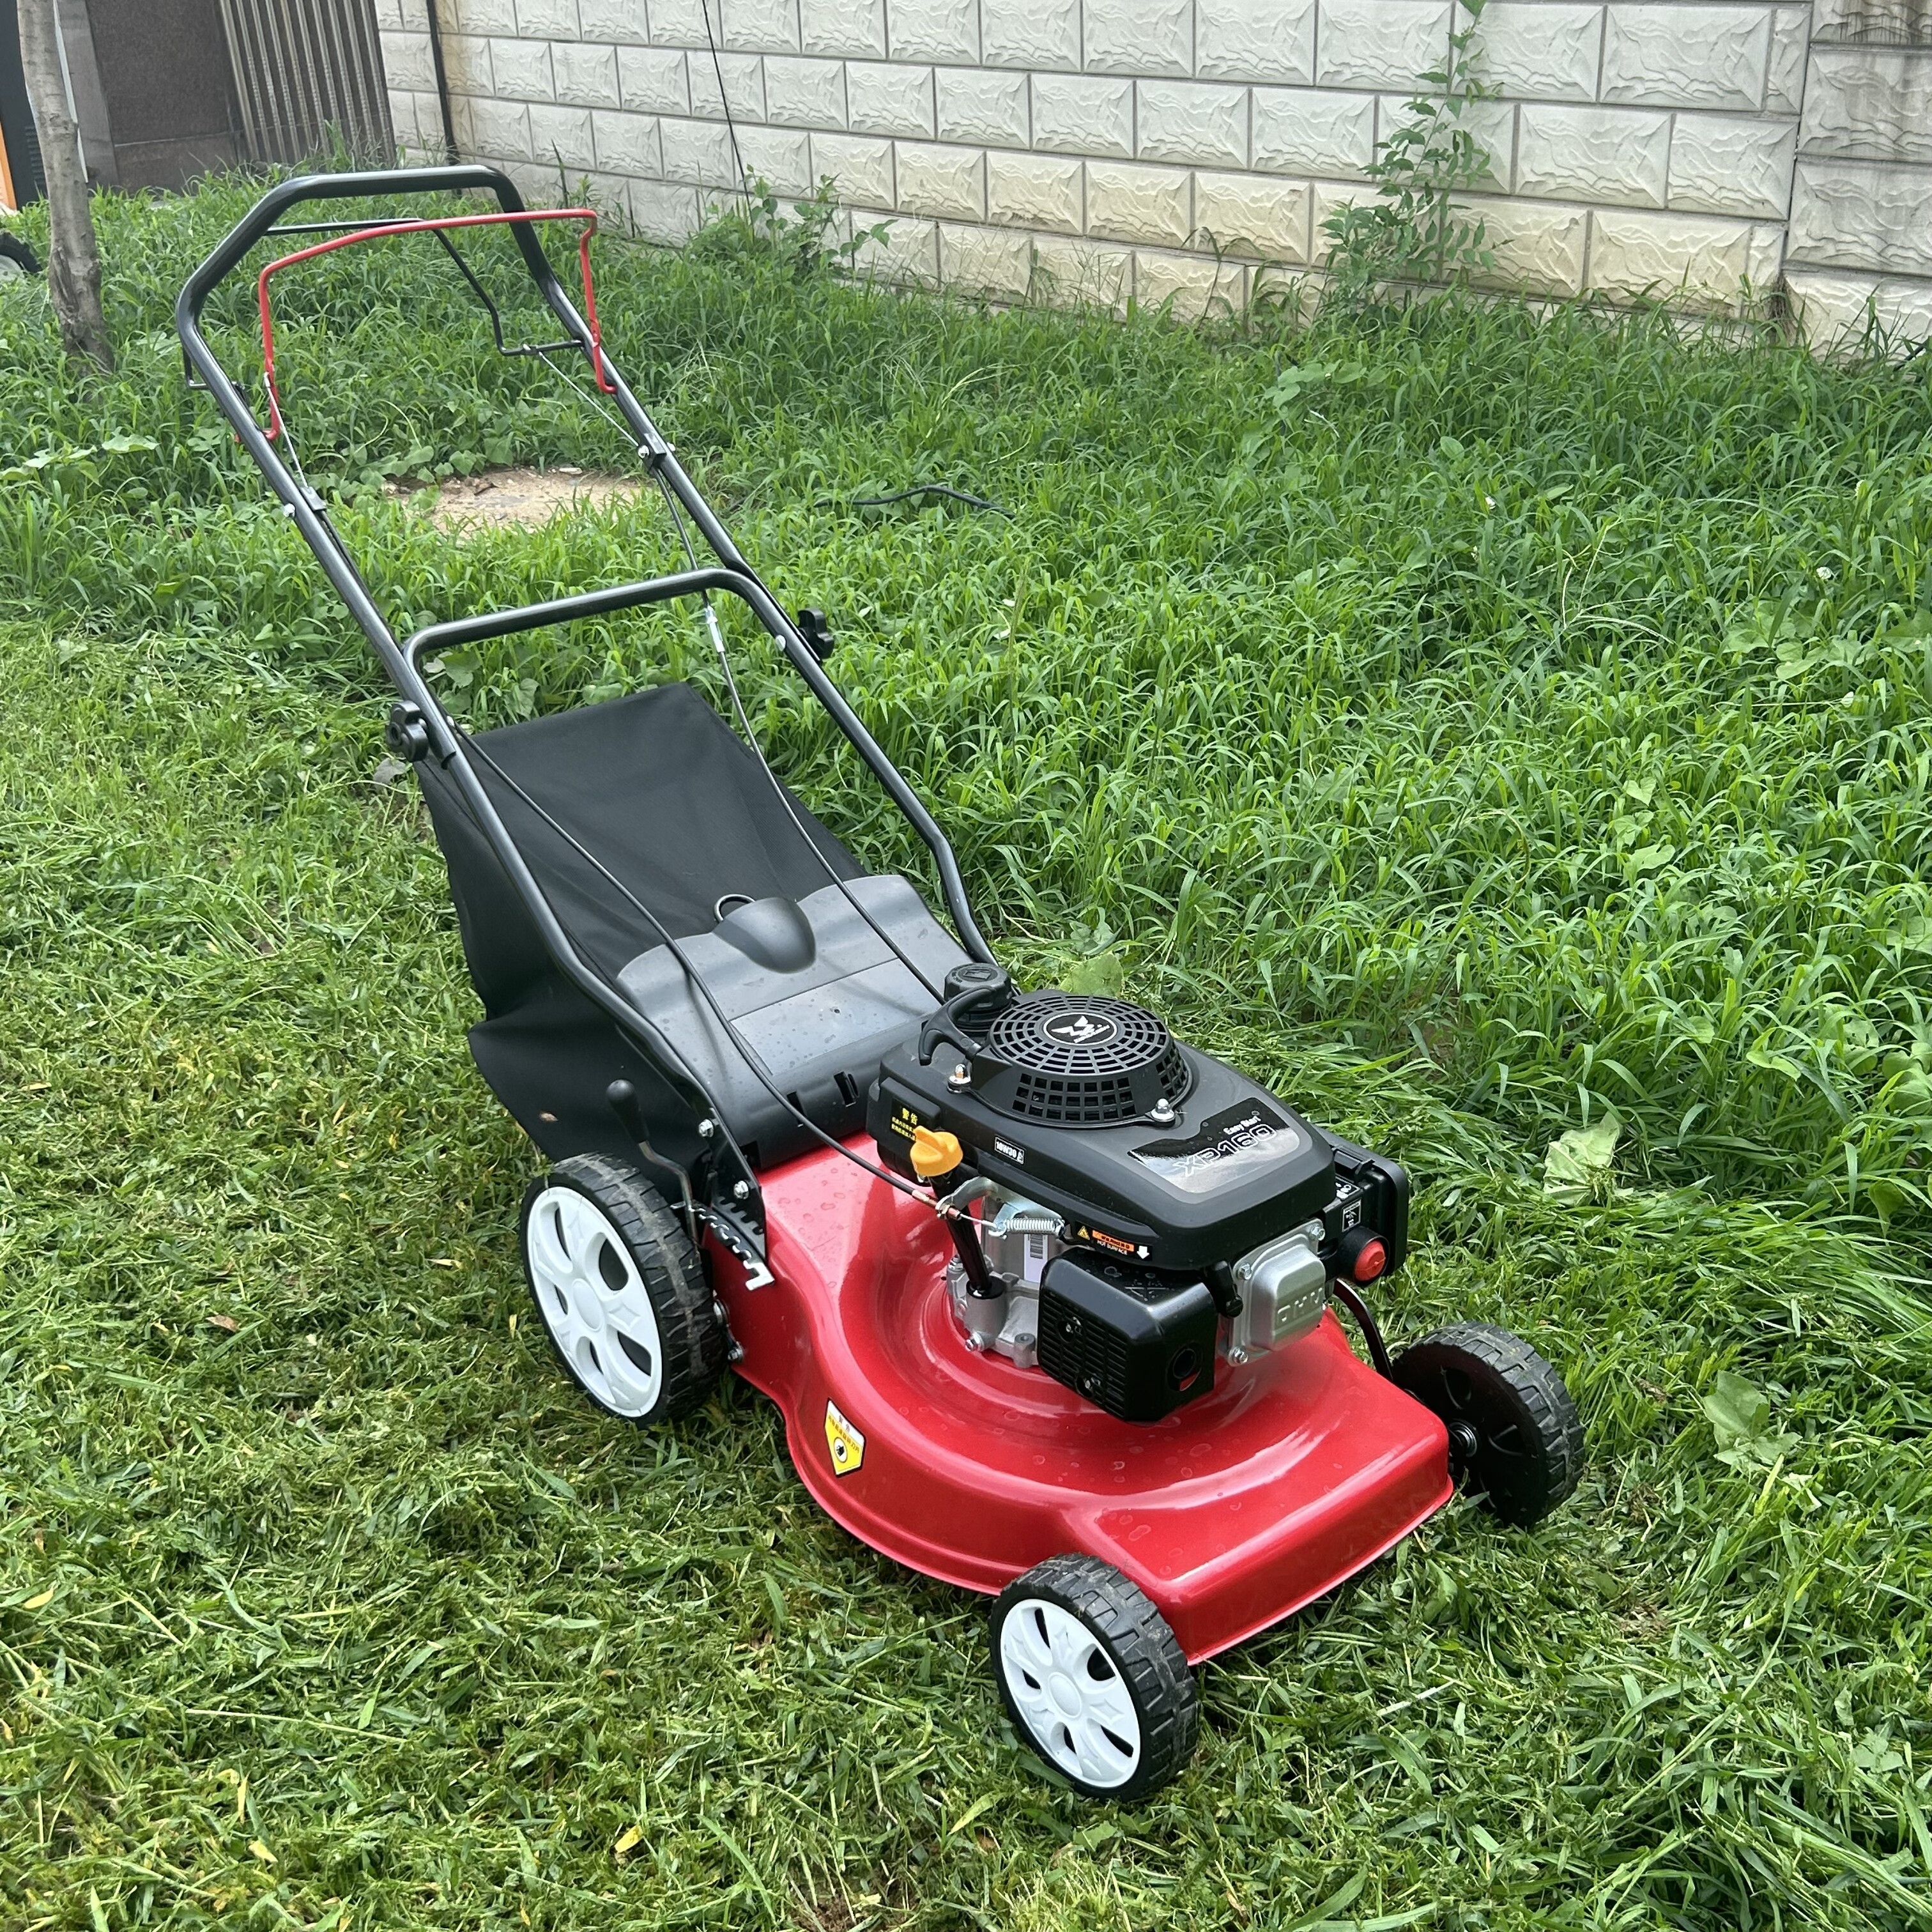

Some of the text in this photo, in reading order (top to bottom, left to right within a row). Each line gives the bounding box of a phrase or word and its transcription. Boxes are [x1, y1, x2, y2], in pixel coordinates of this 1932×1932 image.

[1223, 1124, 1245, 1135] Easy
[996, 1141, 1017, 1158] 10W30
[1172, 1123, 1277, 1177] XP160
